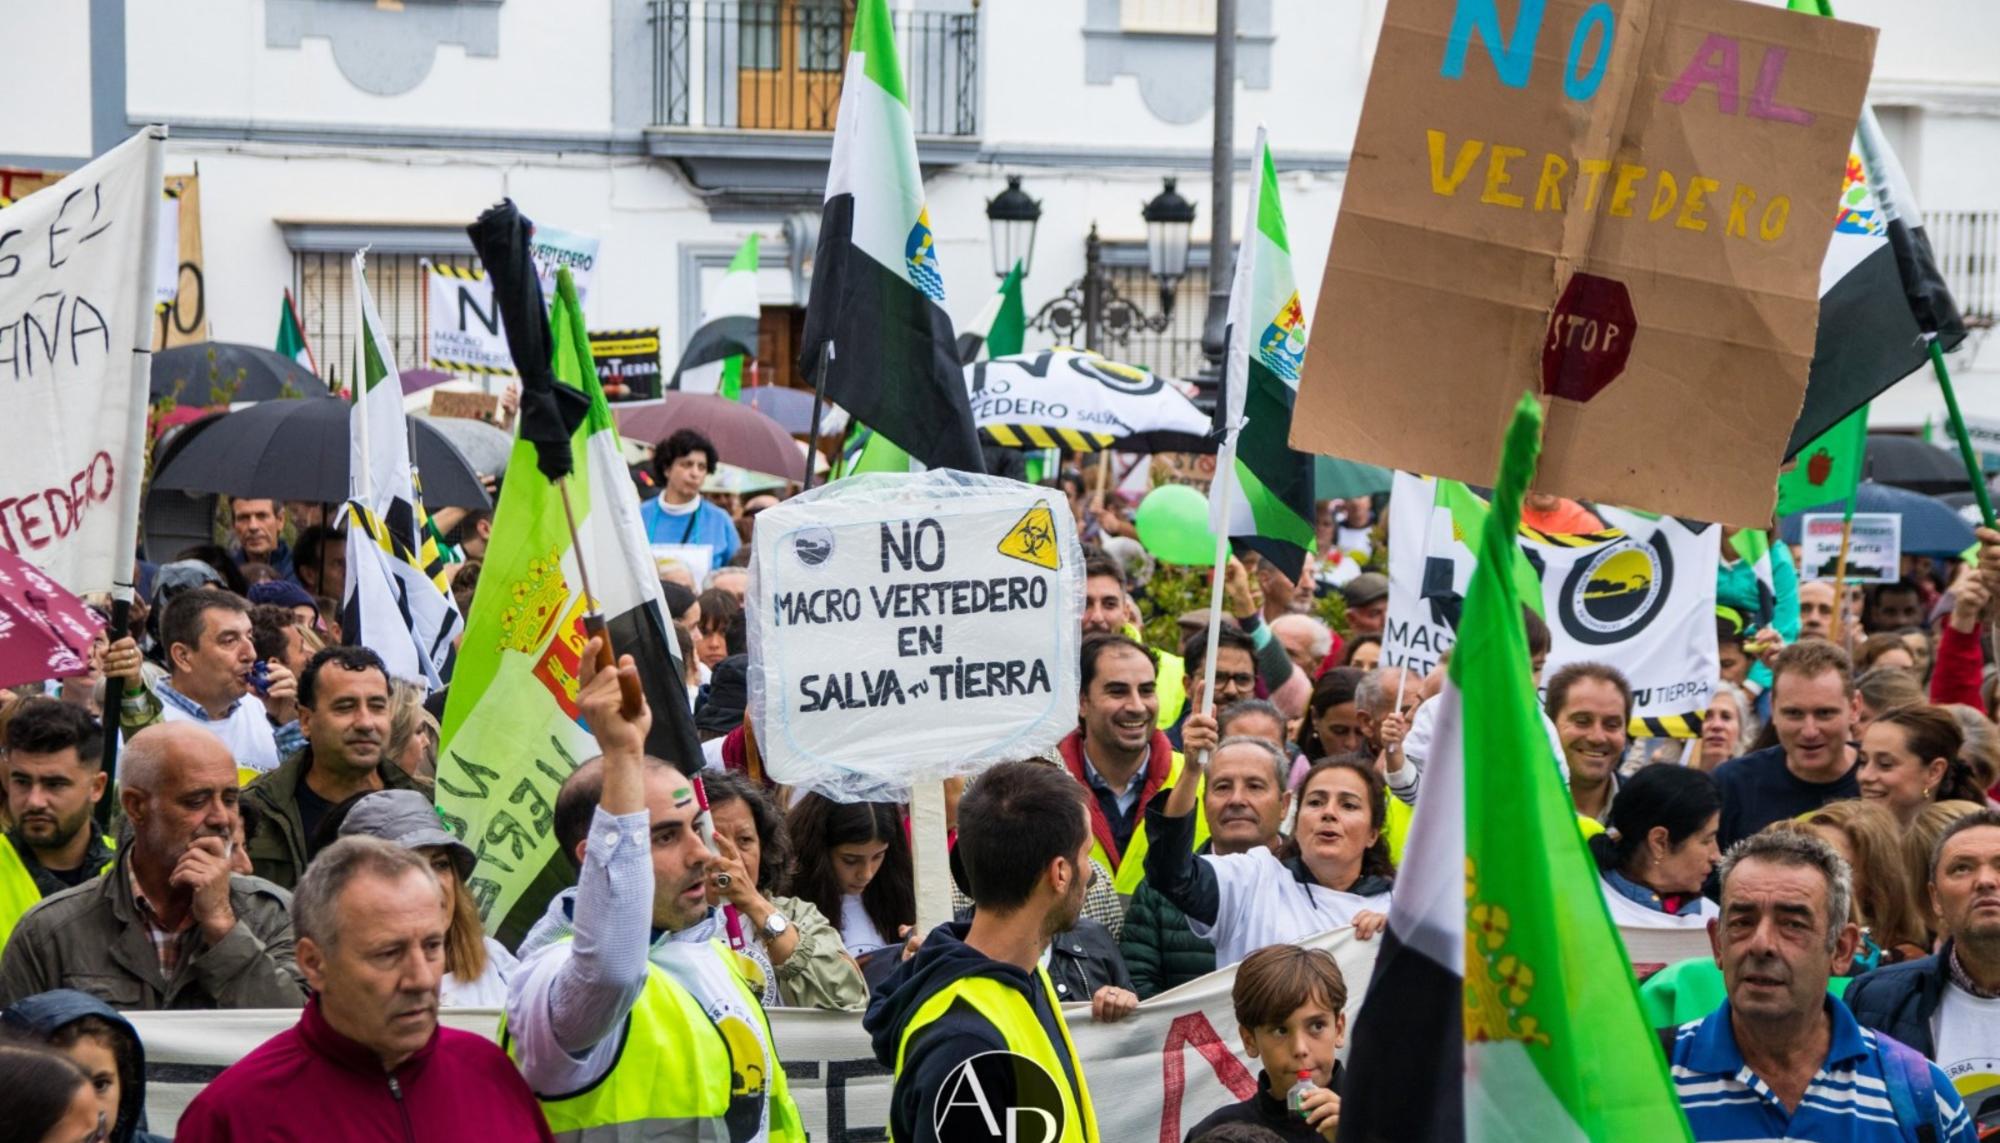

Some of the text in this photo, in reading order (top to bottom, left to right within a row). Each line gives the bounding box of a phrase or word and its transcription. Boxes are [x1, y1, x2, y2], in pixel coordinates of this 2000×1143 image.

[1441, 0, 1816, 127] NO AL
[1427, 130, 1791, 241] VERTEDERO
[1551, 314, 1619, 352] STOP
[881, 518, 945, 573] NO
[774, 575, 1048, 627] MACRO VERTEDERO
[898, 624, 943, 657] EN
[800, 656, 1052, 713] SALVA TU TIERRA
[1655, 680, 1710, 704] TIERRA
